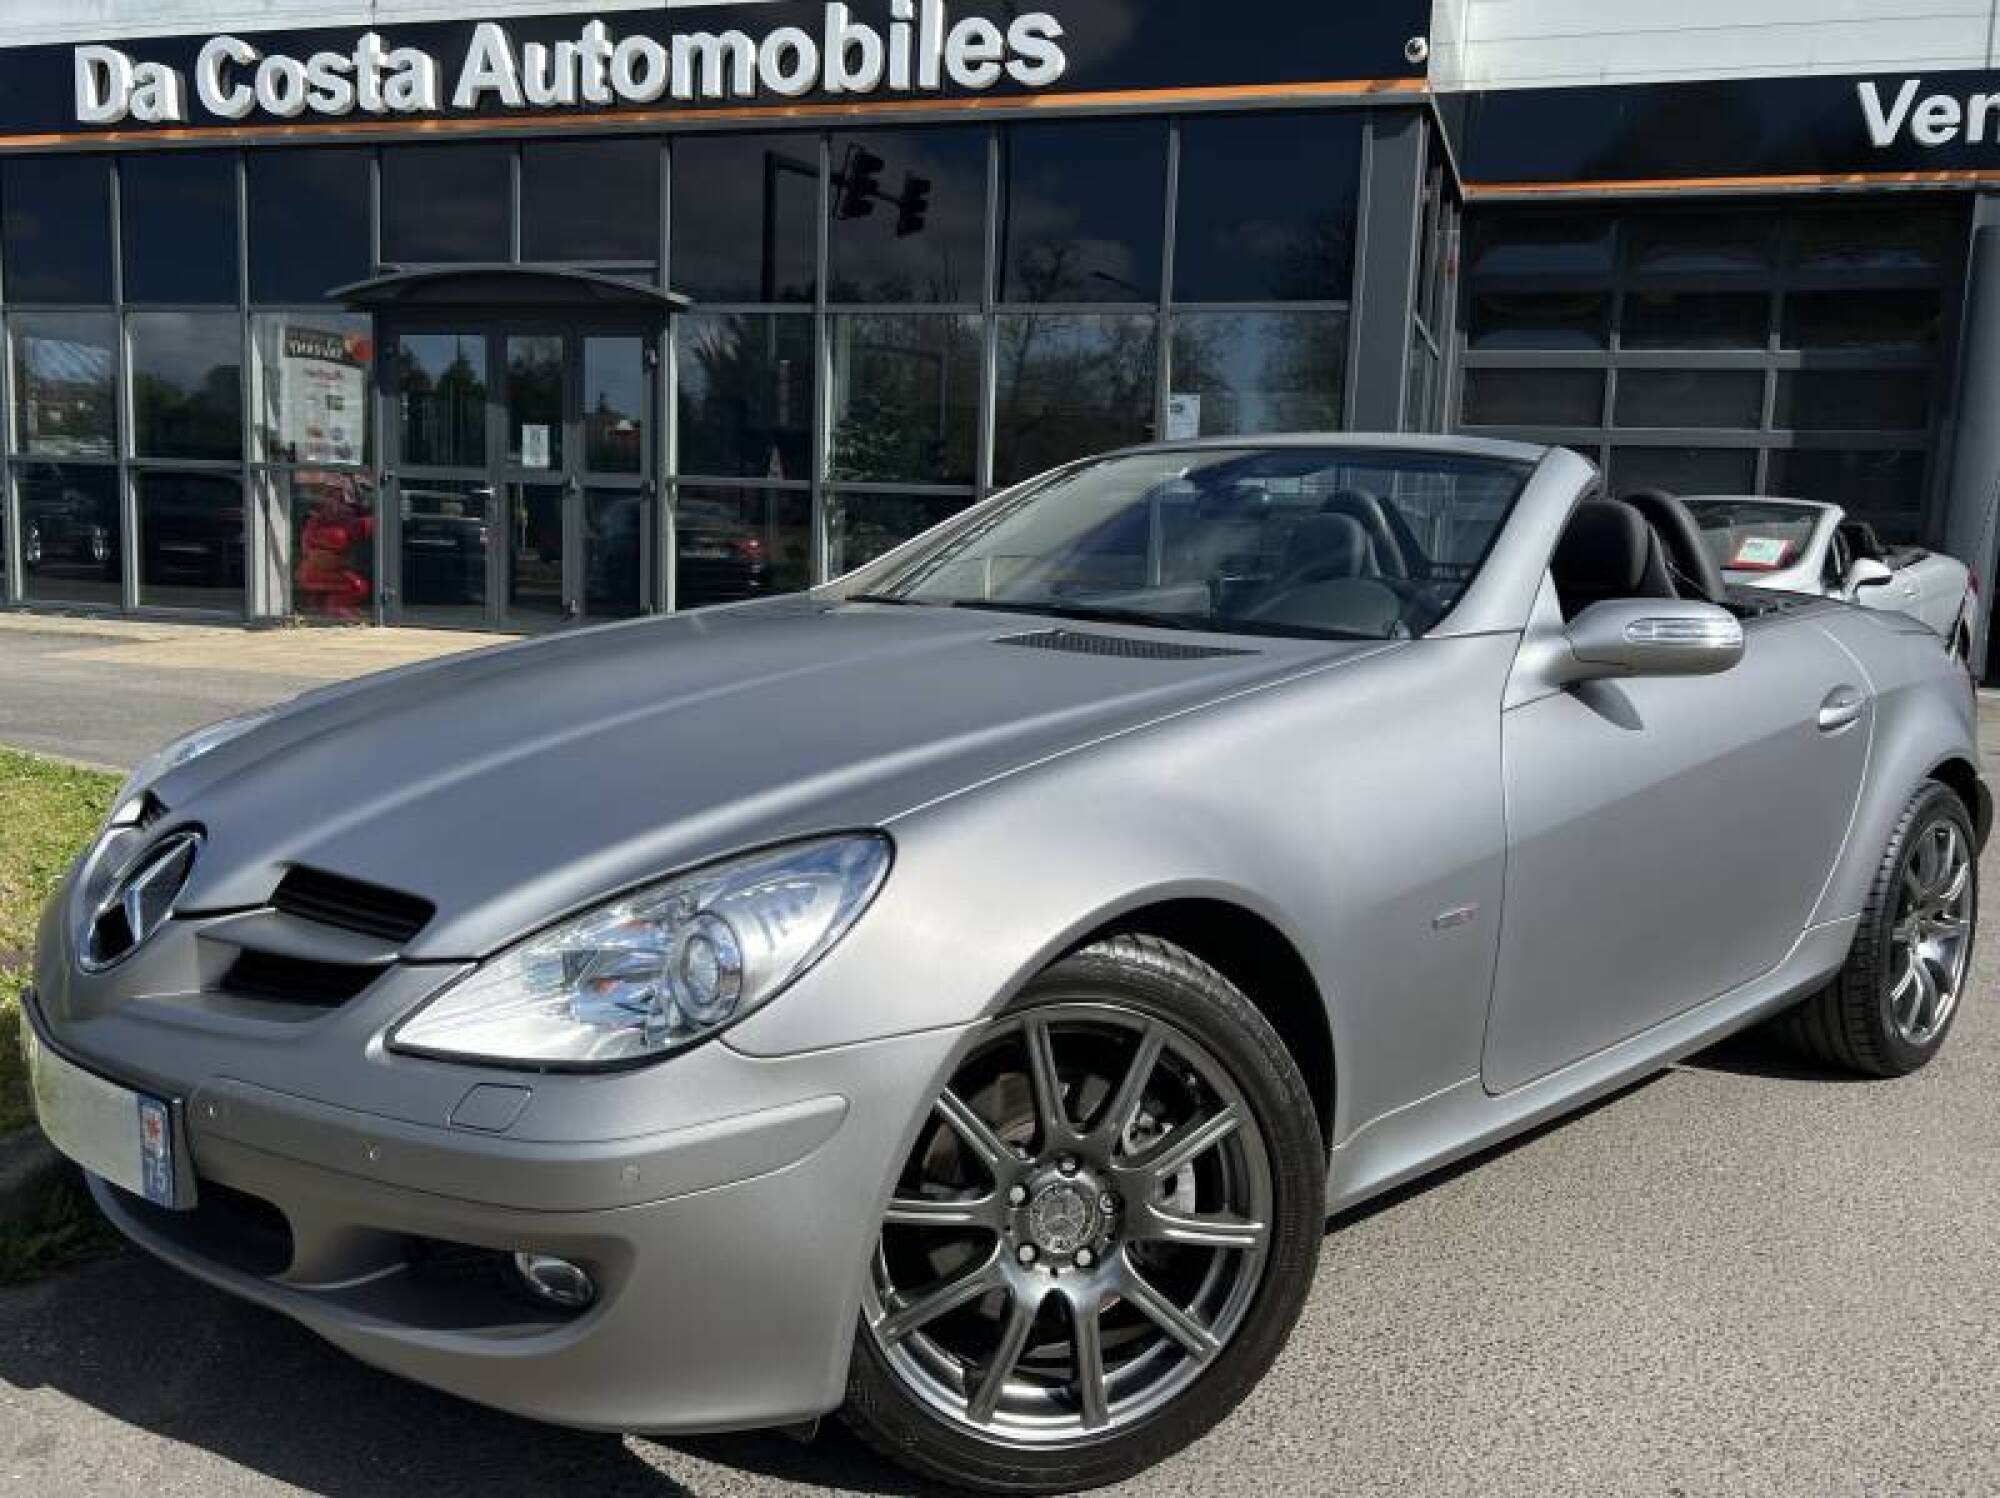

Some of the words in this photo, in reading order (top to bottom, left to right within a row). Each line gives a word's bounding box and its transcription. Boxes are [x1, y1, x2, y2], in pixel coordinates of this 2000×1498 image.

[75, 44, 185, 122] Da
[195, 32, 439, 119] Costa
[453, 0, 1067, 108] Automobiles
